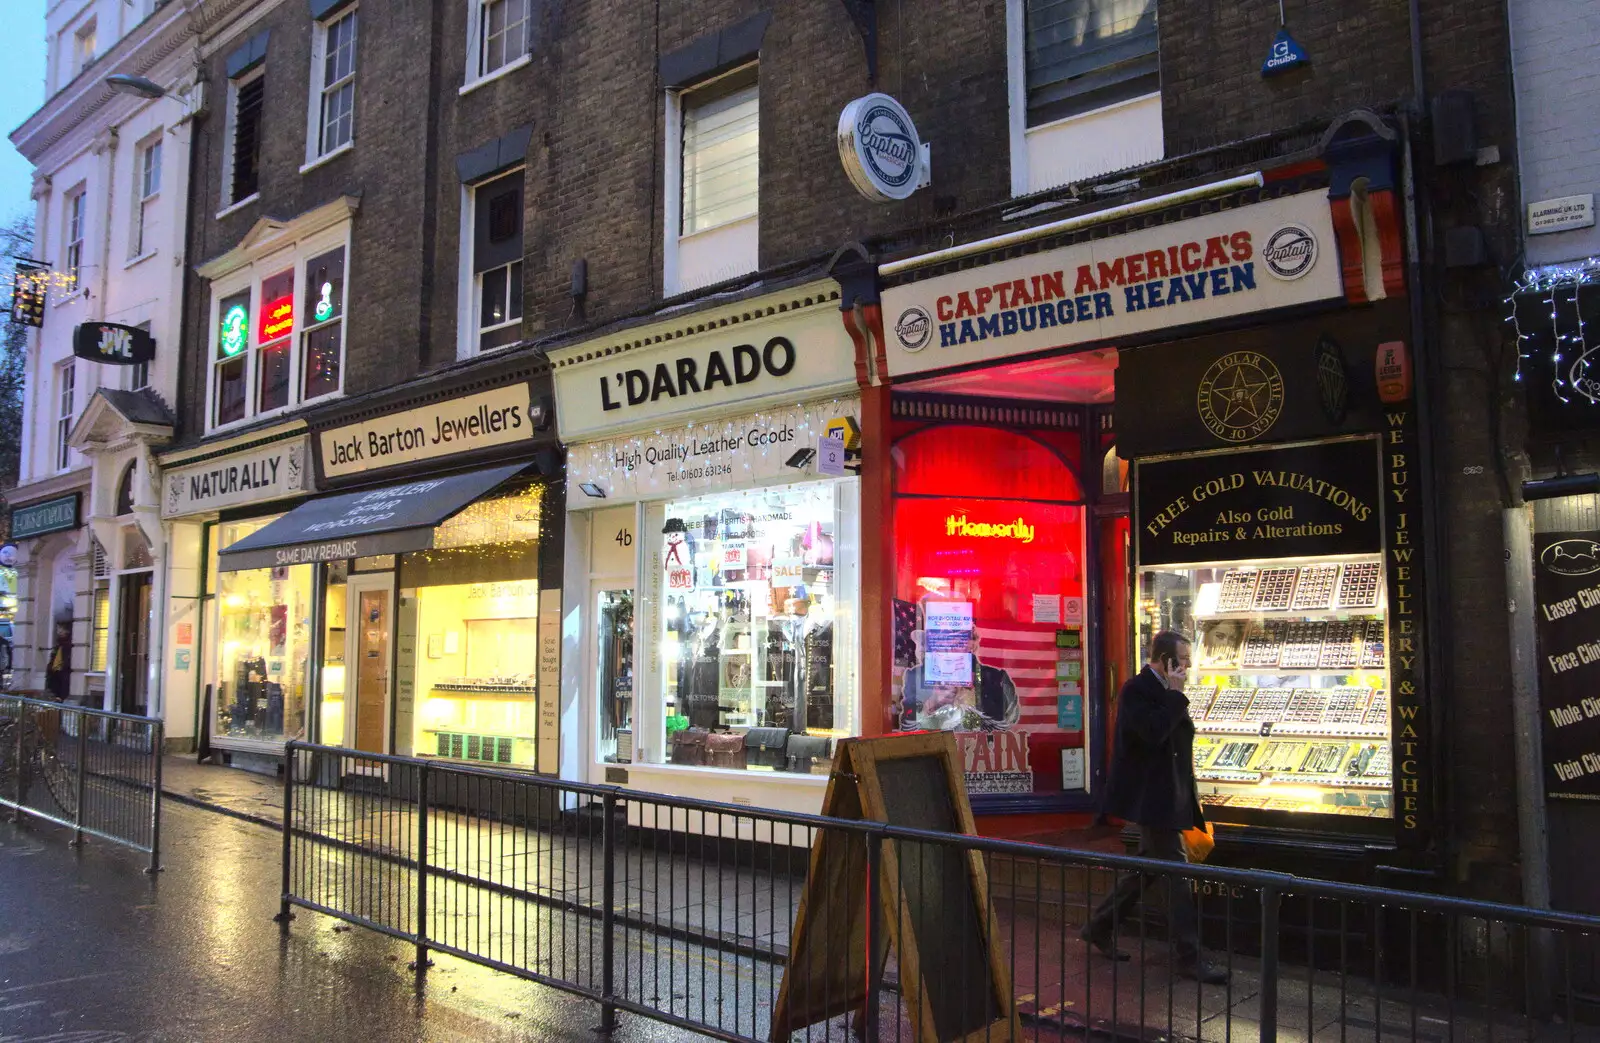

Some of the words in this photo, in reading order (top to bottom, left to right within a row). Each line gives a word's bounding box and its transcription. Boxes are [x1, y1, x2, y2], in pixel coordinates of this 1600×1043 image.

[1267, 53, 1297, 67] Chubb
[857, 122, 914, 165] Captain
[1564, 205, 1572, 213] UK
[1262, 242, 1313, 262] Captain
[936, 270, 1065, 322] CAPTAIN
[1074, 231, 1254, 293] AMERICA'S
[940, 294, 1114, 348] HAMBURGER
[1126, 262, 1257, 325] HEAVEN
[895, 321, 929, 338] Captain
[600, 336, 796, 411] L'DARADO
[1214, 353, 1261, 371] TOLAR
[1265, 371, 1282, 401] THE
[1199, 378, 1226, 436] QUALITY
[1231, 427, 1247, 439] OF
[1251, 406, 1278, 437] SIGN
[1386, 411, 1406, 444] WE
[330, 438, 362, 467] Jack
[369, 426, 425, 459] Barton
[432, 404, 522, 444] Jewellers
[614, 448, 642, 471] High
[645, 442, 688, 464] Quality
[692, 436, 743, 457] Leather
[747, 425, 794, 447] Goods
[190, 456, 281, 501] NATURALLY
[667, 471, 680, 483] Tel.
[681, 468, 703, 482] 01603
[1391, 454, 1408, 503] BUY
[352, 480, 447, 504] JEWELLERY
[1147, 496, 1190, 538] FREE
[1192, 472, 1245, 503] GOLD
[1252, 470, 1372, 522] VALUATIONS
[725, 515, 752, 525] BRITISH
[753, 512, 792, 523] HANDMADE
[1216, 510, 1251, 525] Also
[1257, 506, 1294, 521] Gold
[616, 528, 632, 546] 4b
[1172, 528, 1230, 547] Repairs
[1235, 527, 1247, 540] &
[1253, 522, 1342, 540] Alterations
[276, 547, 300, 564] SAME
[302, 545, 320, 562] DAY
[320, 540, 358, 560] REPAIRS
[670, 573, 692, 588] SALE
[774, 565, 802, 577] SALE
[468, 585, 487, 599] Jack
[1392, 512, 1415, 671] JEWELLERY
[1542, 599, 1578, 622] Laser
[542, 656, 557, 665] Bought
[1548, 650, 1580, 674] Face
[1398, 680, 1416, 696] &
[1550, 704, 1582, 729] Mole
[1398, 705, 1421, 830] WATCHES
[1554, 758, 1582, 783] Vein
